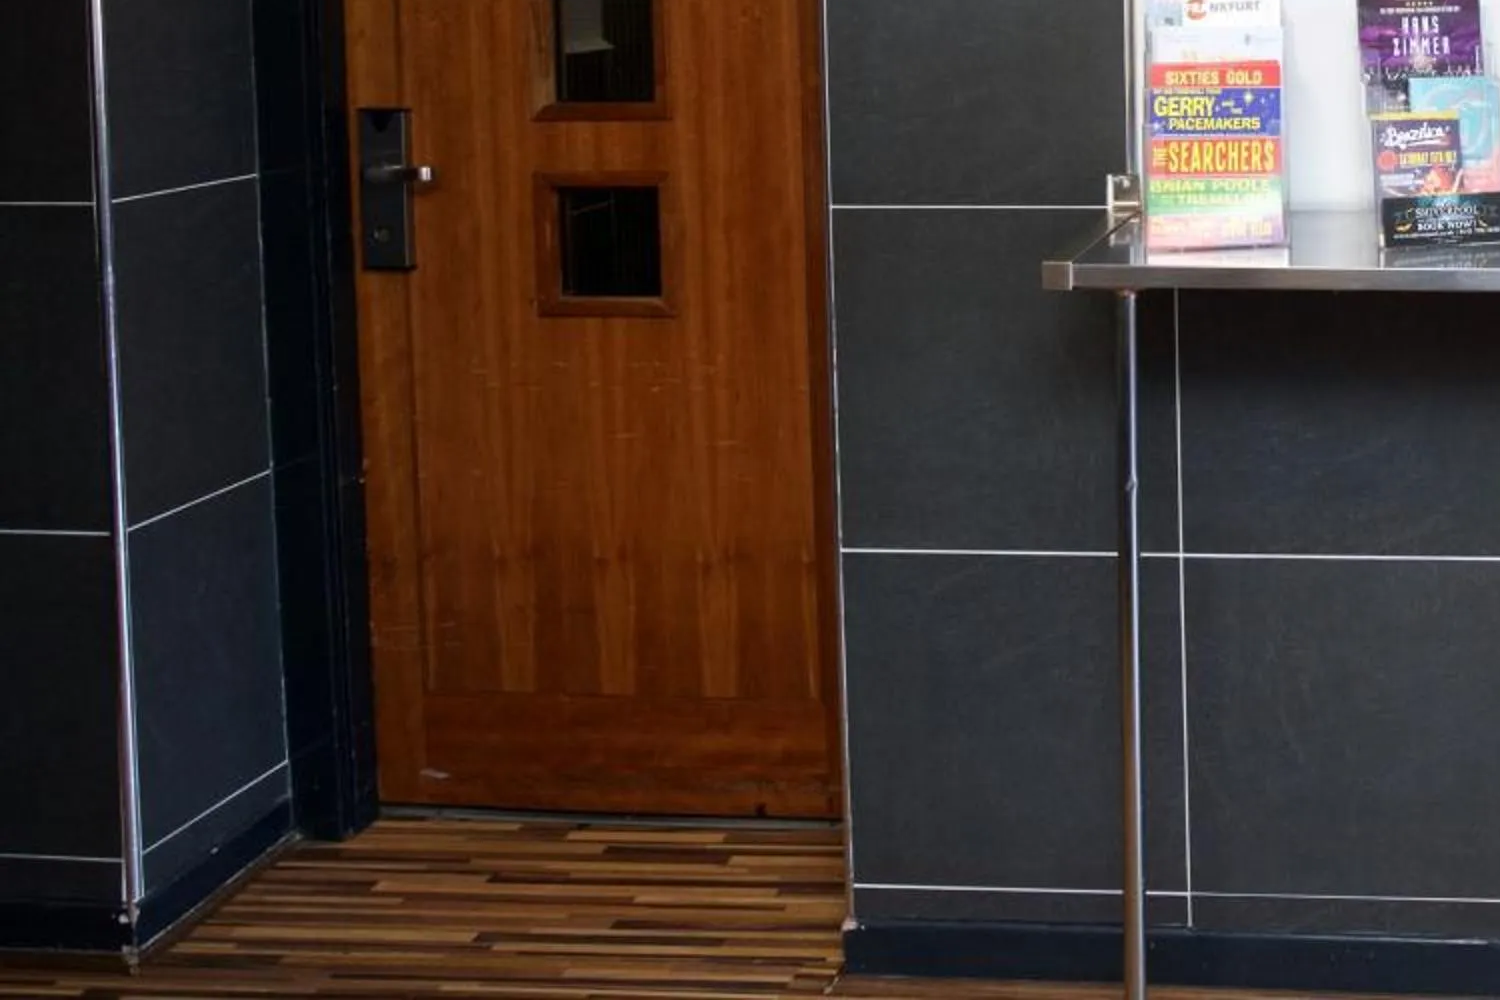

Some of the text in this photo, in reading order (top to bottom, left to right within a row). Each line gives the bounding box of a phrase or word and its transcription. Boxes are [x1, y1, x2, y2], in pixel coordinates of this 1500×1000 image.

[1401, 15, 1440, 34] HANS
[1392, 36, 1450, 57] ZIMMER
[1164, 69, 1262, 86] SIXTIES GOLD
[1153, 95, 1216, 117] GERRY
[1168, 116, 1261, 131] PACEMAKERS
[1167, 140, 1275, 173] SEARCHERS
